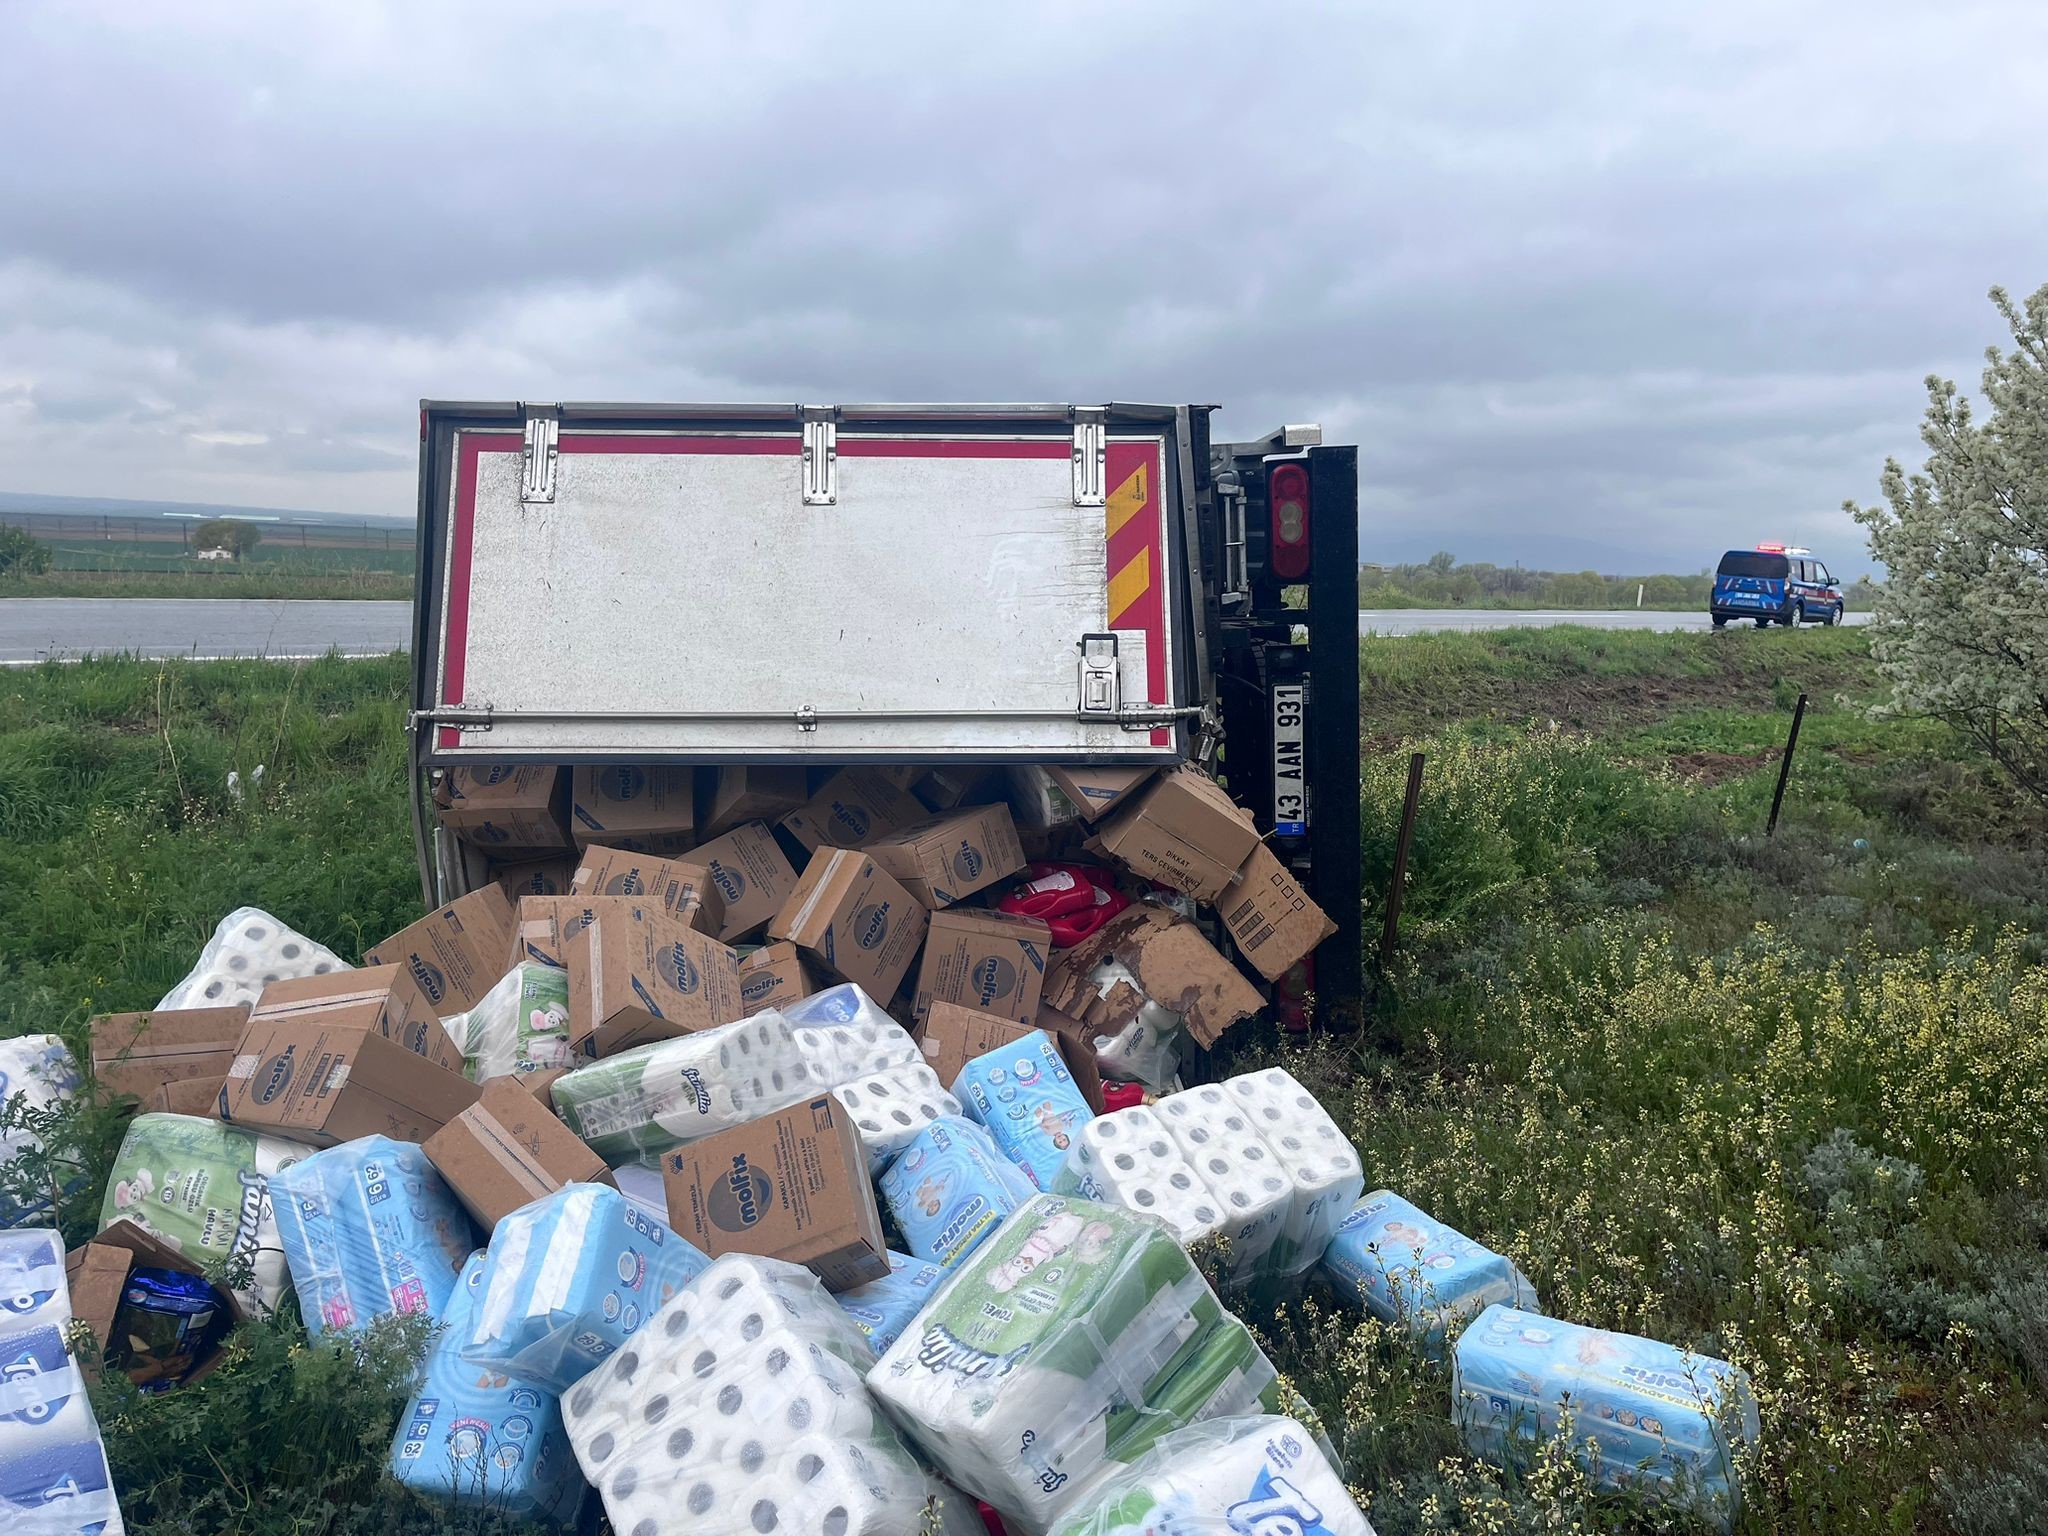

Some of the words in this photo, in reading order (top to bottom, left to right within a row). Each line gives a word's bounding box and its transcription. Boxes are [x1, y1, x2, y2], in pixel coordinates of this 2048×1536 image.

[1276, 689, 1301, 727] 931
[1277, 741, 1302, 780] AAN
[831, 801, 866, 836] molfix
[1277, 795, 1302, 821] 43
[1291, 823, 1300, 833] TR
[961, 839, 978, 878] molfix
[1140, 848, 1158, 863] TERS
[1165, 849, 1190, 868] DİKKAT
[624, 867, 640, 896] olfix
[709, 859, 739, 900] molfix
[862, 901, 891, 947] molfix
[409, 952, 441, 1001] molfix
[676, 941, 689, 993] molfix
[979, 958, 997, 1006] molfix
[742, 975, 784, 998] molfix
[414, 1021, 428, 1052] olfix
[261, 1043, 296, 1102] molfix
[680, 1067, 710, 1114] familia
[366, 1163, 379, 1181] 62
[731, 1153, 756, 1223] molfix
[368, 1184, 383, 1196] 6
[778, 1180, 790, 1209] KAPAKLI
[200, 1209, 216, 1246] HAVLU
[930, 1196, 982, 1253] molfix
[981, 1302, 1012, 1321] TOWEL
[417, 1422, 429, 1436] 6
[404, 1443, 421, 1454] 62
